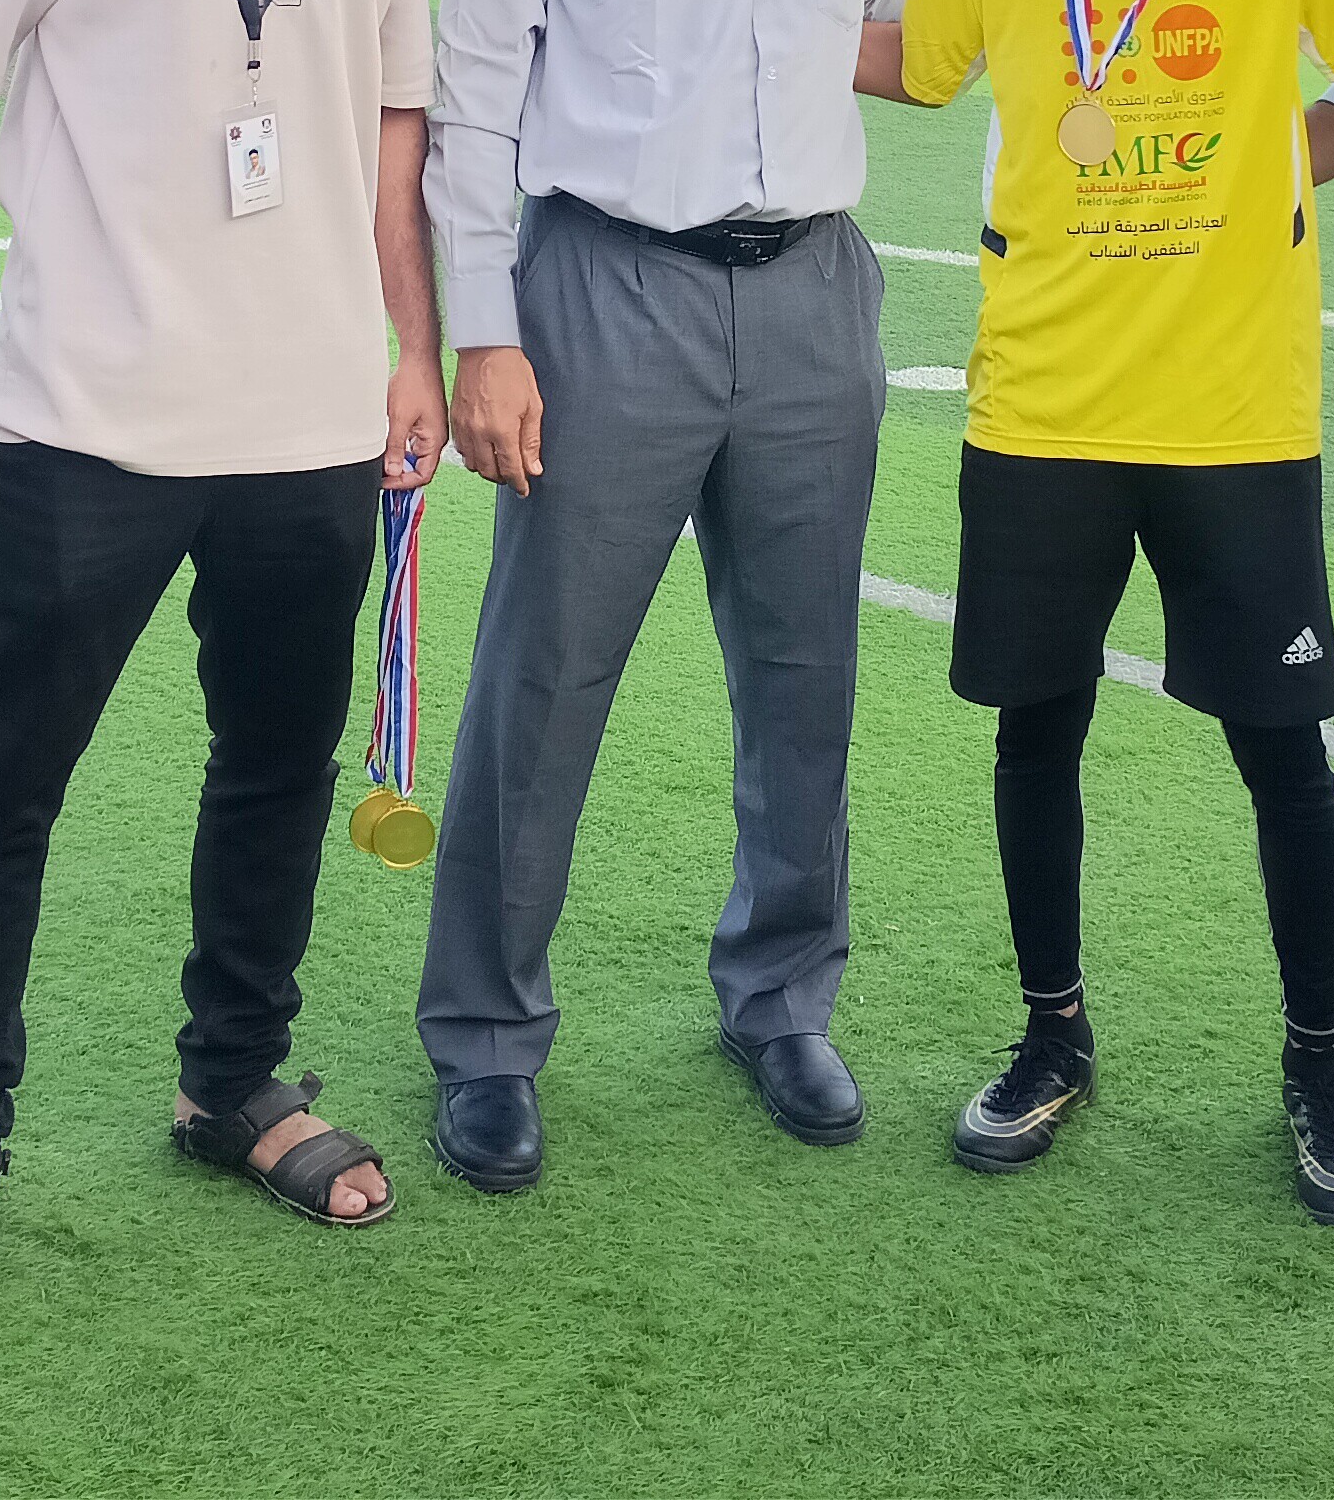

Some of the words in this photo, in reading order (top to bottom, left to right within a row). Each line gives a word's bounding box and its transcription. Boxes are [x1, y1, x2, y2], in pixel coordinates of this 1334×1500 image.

[1151, 27, 1224, 59] UNFPA
[1107, 93, 1150, 108] المتحدة
[1154, 89, 1184, 108] الأمم
[1113, 113, 1142, 124] TIONS
[1144, 110, 1201, 123] POPULATION
[1076, 197, 1103, 207] Field
[1104, 195, 1144, 207] Medical
[1147, 192, 1207, 204] Foundation
[1067, 220, 1110, 238] للشباب
[1114, 218, 1170, 236] الصديقة
[1174, 214, 1228, 232] العيادات
[1089, 244, 1137, 261] الشباب
[1142, 240, 1200, 260] المثقفين
